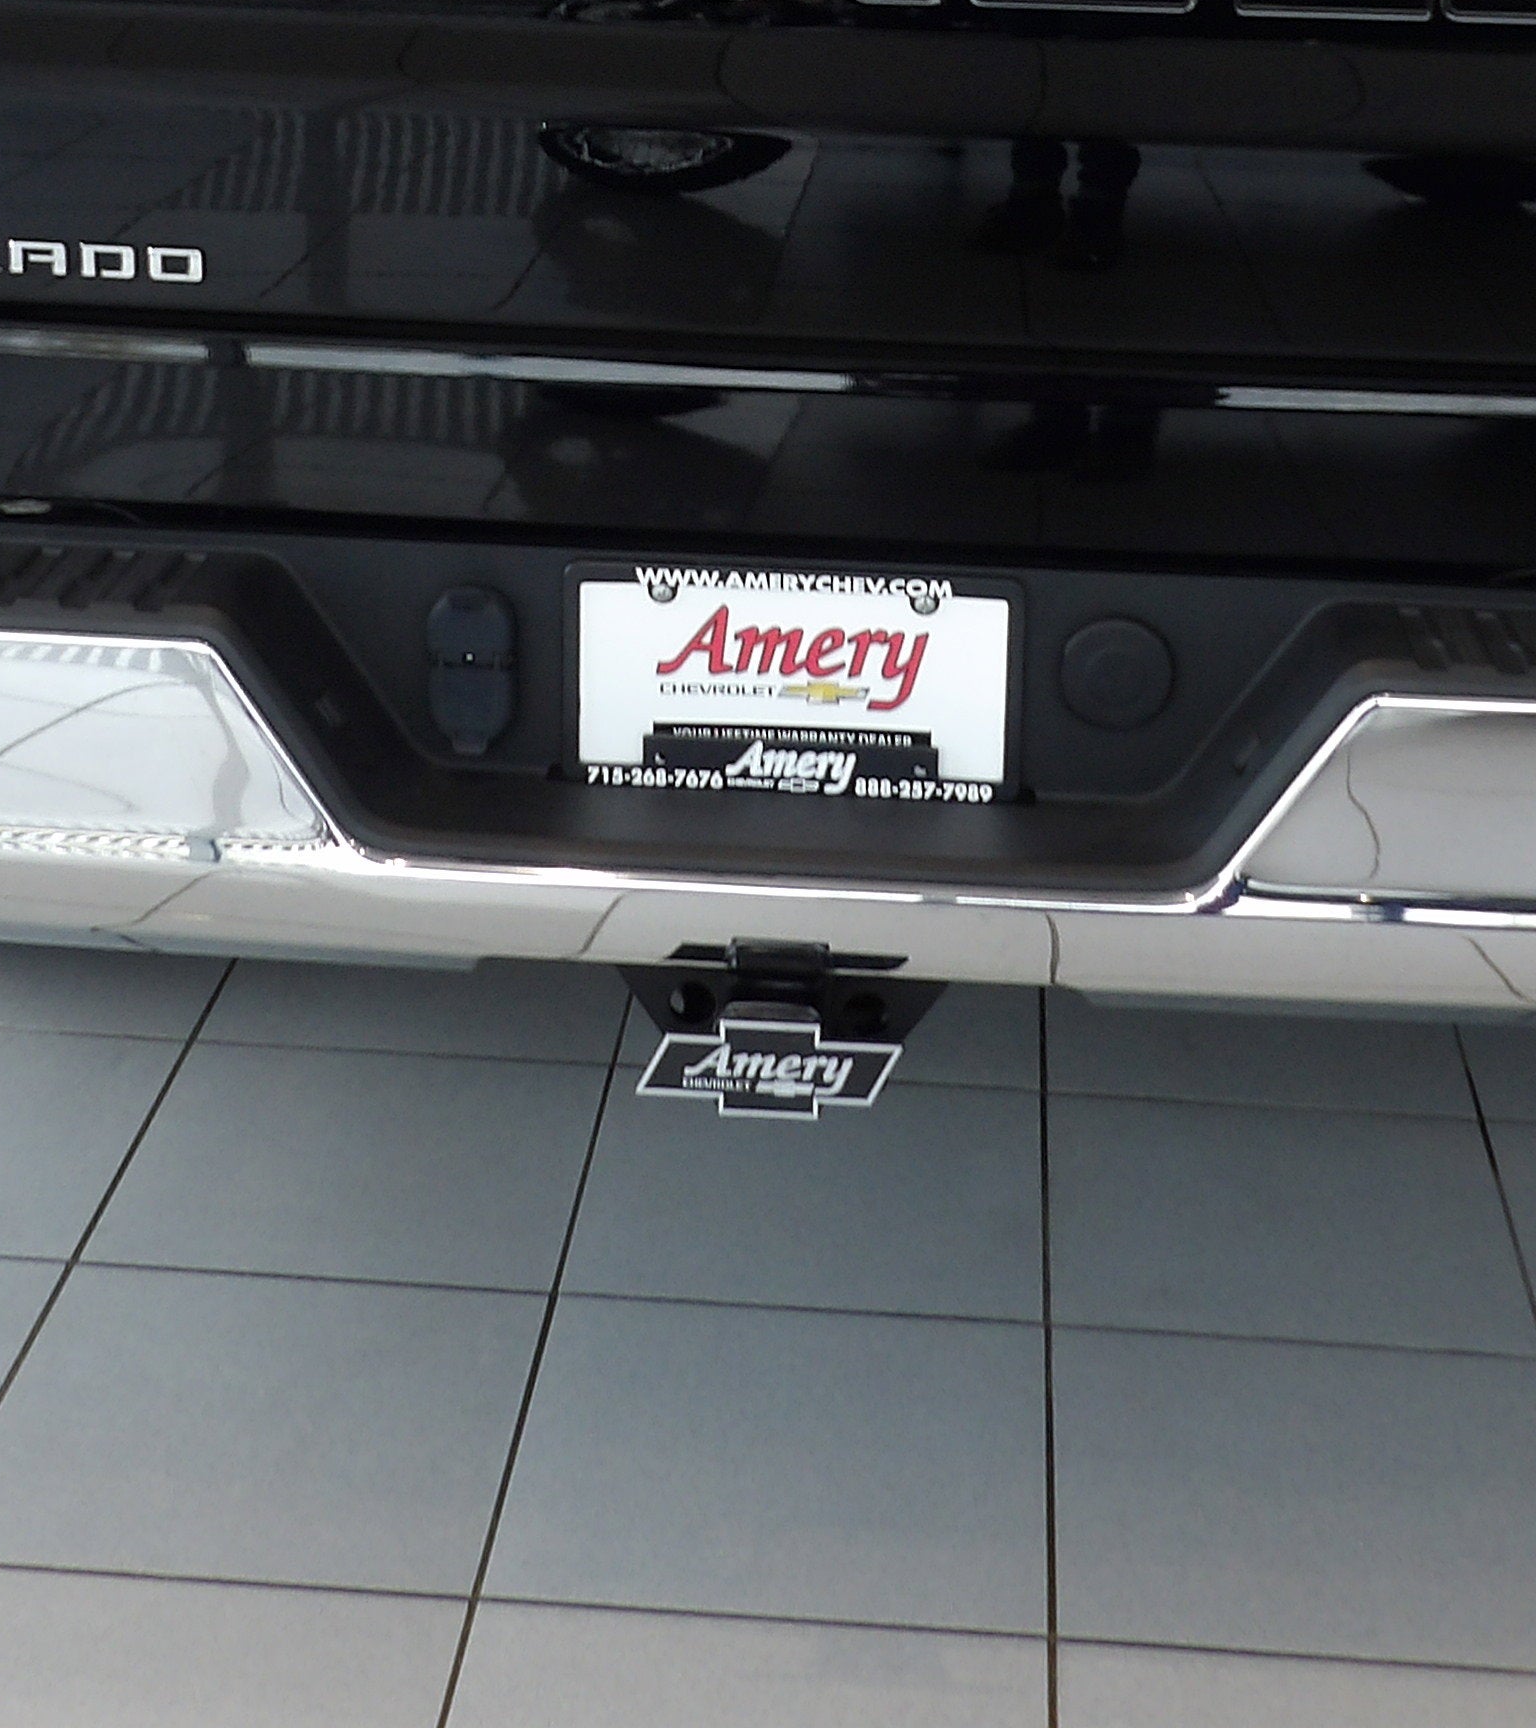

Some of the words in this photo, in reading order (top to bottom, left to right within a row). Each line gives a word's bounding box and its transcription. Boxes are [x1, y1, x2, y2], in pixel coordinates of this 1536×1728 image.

[635, 566, 953, 599] WWW.AMERYCHEV.COM
[656, 604, 929, 711] Amery
[659, 681, 776, 698] CHEVROLET
[673, 726, 712, 738] YOUR
[777, 730, 855, 743] WARRANTY
[858, 732, 913, 747] DEALER
[725, 739, 857, 795] Amery
[683, 1043, 854, 1096] Amery
